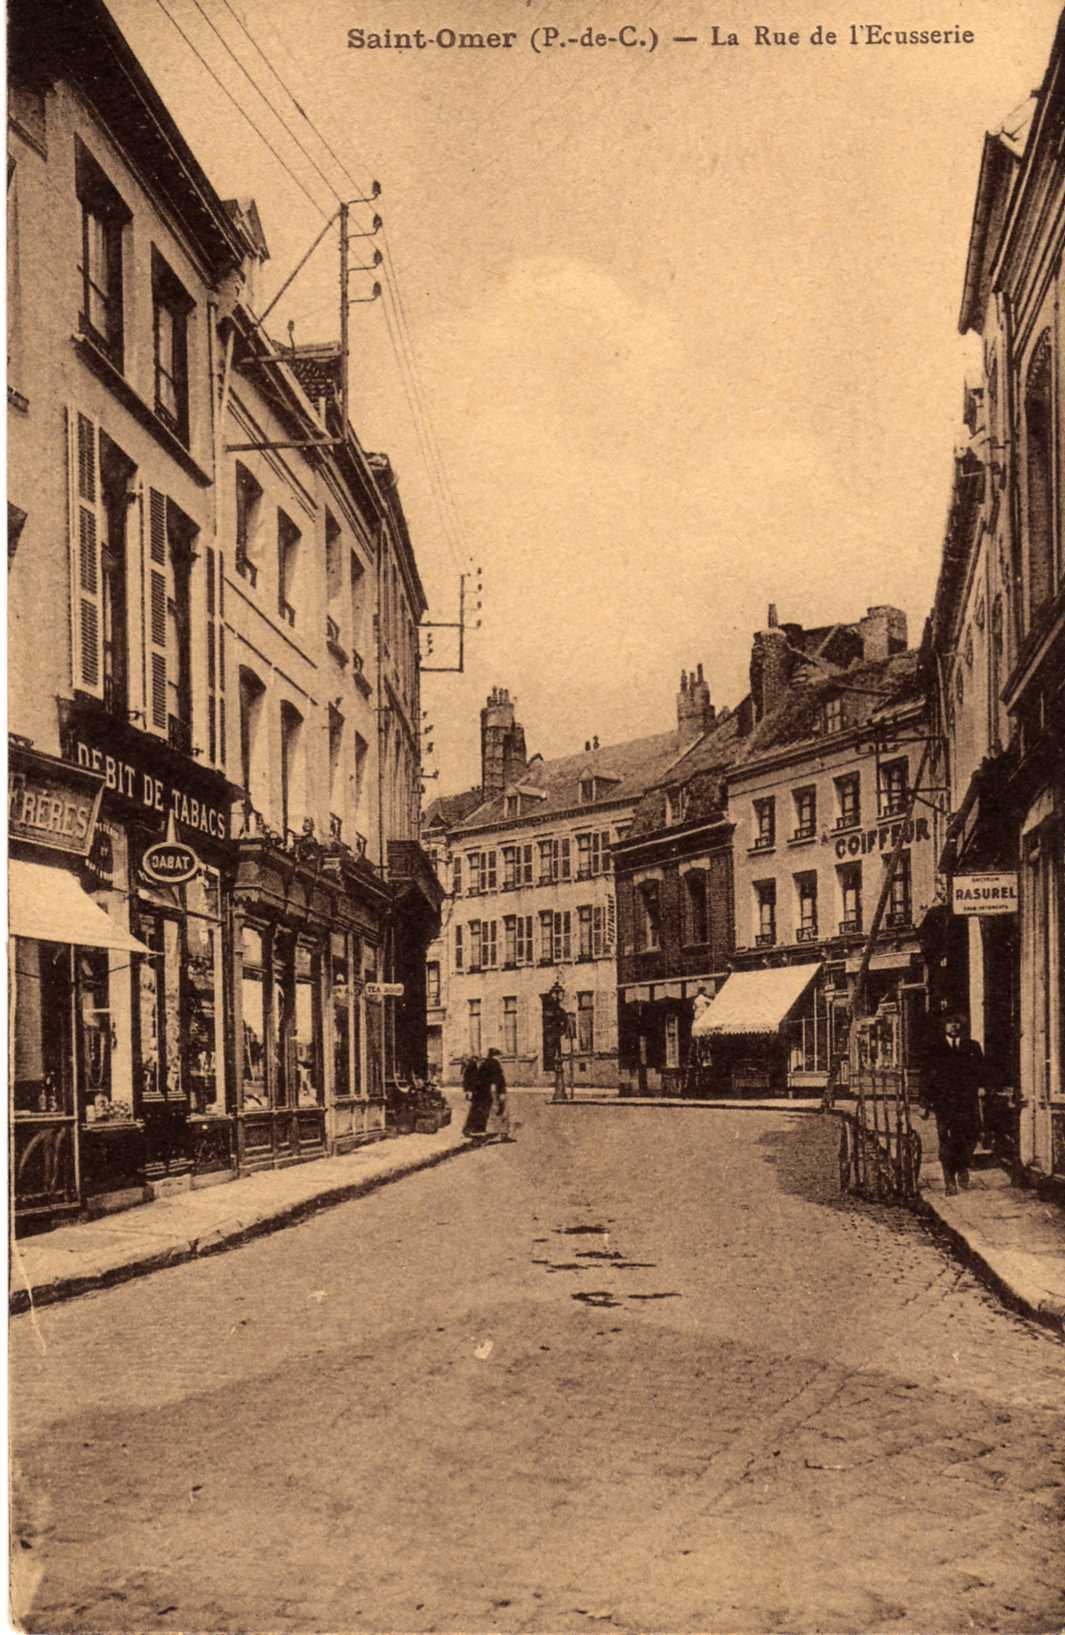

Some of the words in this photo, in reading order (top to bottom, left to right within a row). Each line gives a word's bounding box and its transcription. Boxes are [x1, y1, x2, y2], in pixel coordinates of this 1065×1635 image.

[143, 774, 164, 811] DE
[171, 789, 226, 840] TABACS
[955, 887, 1017, 900] RASUREL
